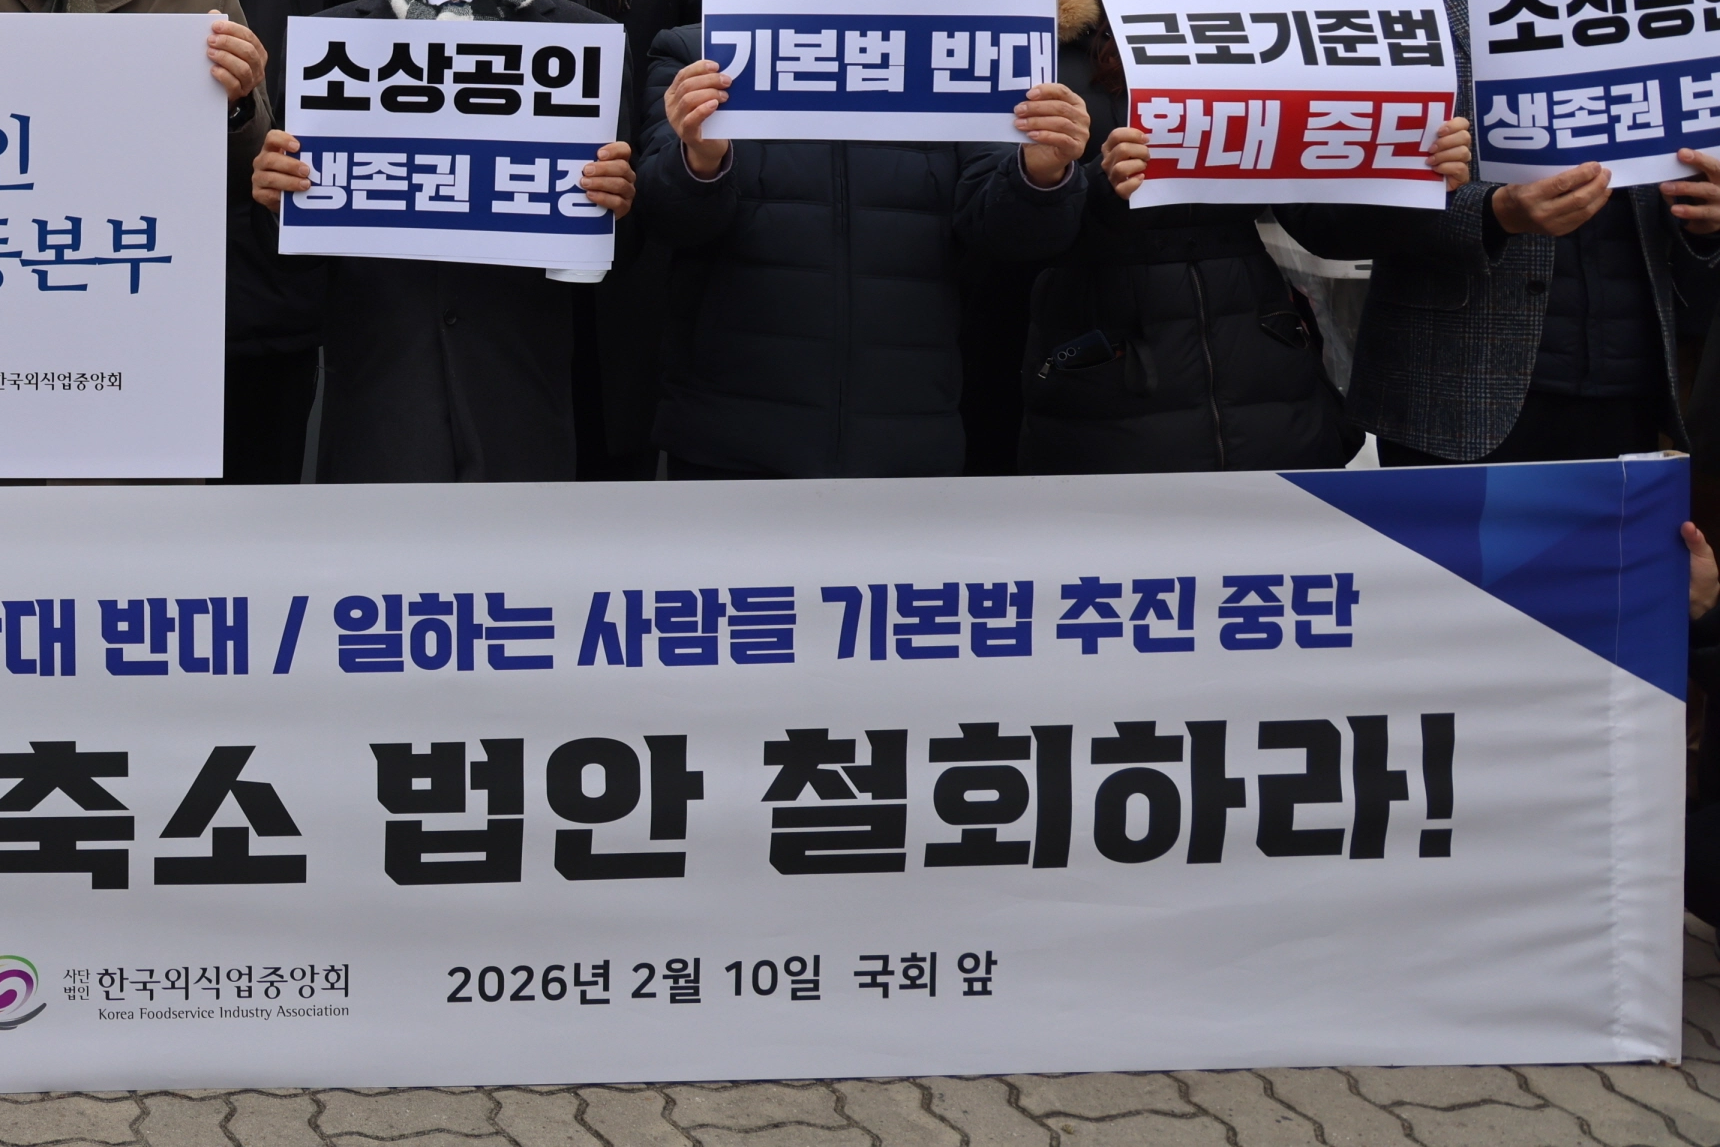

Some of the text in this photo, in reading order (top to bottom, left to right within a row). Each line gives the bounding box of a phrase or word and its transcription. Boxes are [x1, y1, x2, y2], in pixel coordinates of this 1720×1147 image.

[710, 28, 1052, 93] 기본법 반대
[1120, 9, 1445, 67] 근로기준법
[300, 41, 602, 118] 소상공인
[1137, 97, 1446, 171] 확대 중단
[1483, 79, 1665, 150] 생존권
[292, 151, 471, 213] 생존권
[97, 596, 249, 676] 반대
[272, 595, 310, 674] /
[333, 591, 556, 674] 일하는
[577, 585, 797, 668] 사람들
[820, 580, 1034, 661] 기본법
[1055, 575, 1197, 656] 추진
[1217, 571, 1361, 652] 중단
[369, 734, 704, 886] 법안
[761, 712, 1456, 876] 철회하라!
[63, 968, 91, 984] 사단
[63, 985, 91, 1001] 법인
[96, 964, 350, 1001] 한국외식업중앙회
[446, 950, 999, 1006] 2026년 2월 10일 국회 앞
[98, 1003, 350, 1021] Korea Foodservice Industry Association
